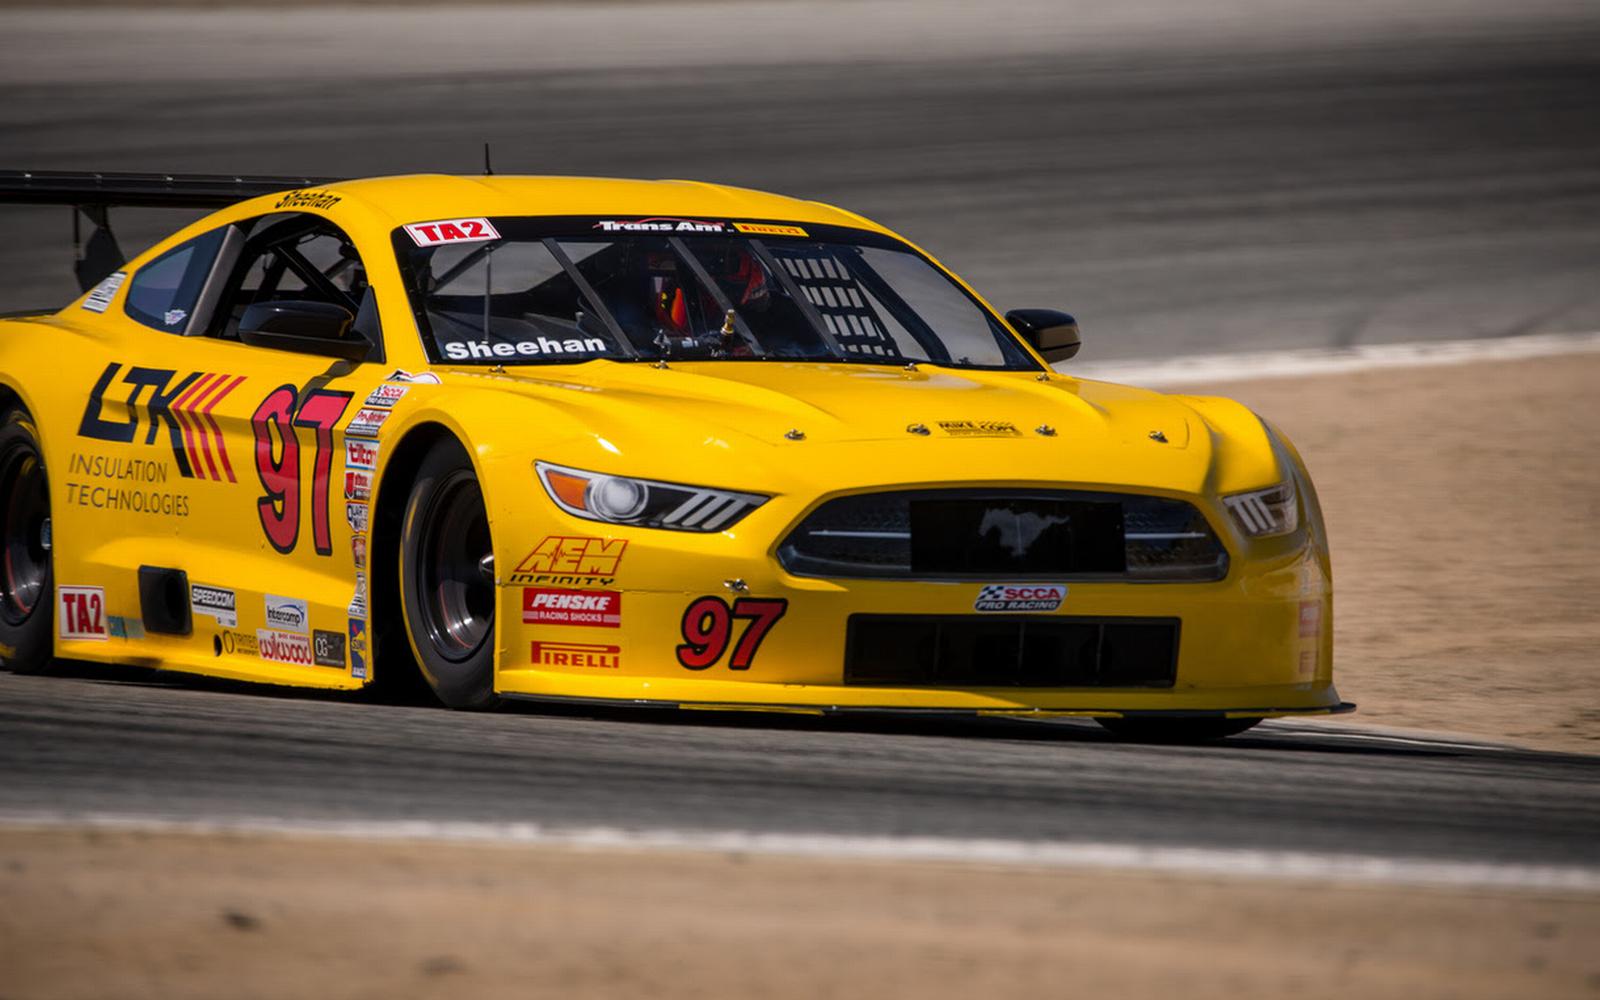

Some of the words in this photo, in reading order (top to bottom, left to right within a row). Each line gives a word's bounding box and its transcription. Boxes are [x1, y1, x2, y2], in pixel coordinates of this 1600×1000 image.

[415, 221, 489, 242] TA2
[600, 221, 673, 231] Trans
[675, 222, 722, 232] Am
[445, 337, 606, 359] Sheehan
[77, 362, 206, 478] LTK
[68, 453, 168, 483] INSULATION
[252, 383, 356, 556] 97
[66, 483, 190, 516] TECHNOLOGIES
[513, 536, 629, 576] AEM
[510, 574, 615, 585] INFINITY
[192, 587, 235, 608] SPEEDCOM
[531, 593, 611, 611] PENSKE
[1004, 588, 1061, 600] SCCA
[63, 593, 105, 634] TA2
[267, 605, 301, 627] Intercomp
[539, 611, 569, 621] RACING
[570, 613, 602, 623] SHOCKS
[1007, 602, 1058, 610] RACING
[675, 595, 788, 670] 97
[260, 633, 312, 665] wilwood
[531, 641, 621, 669] PIRELLI
